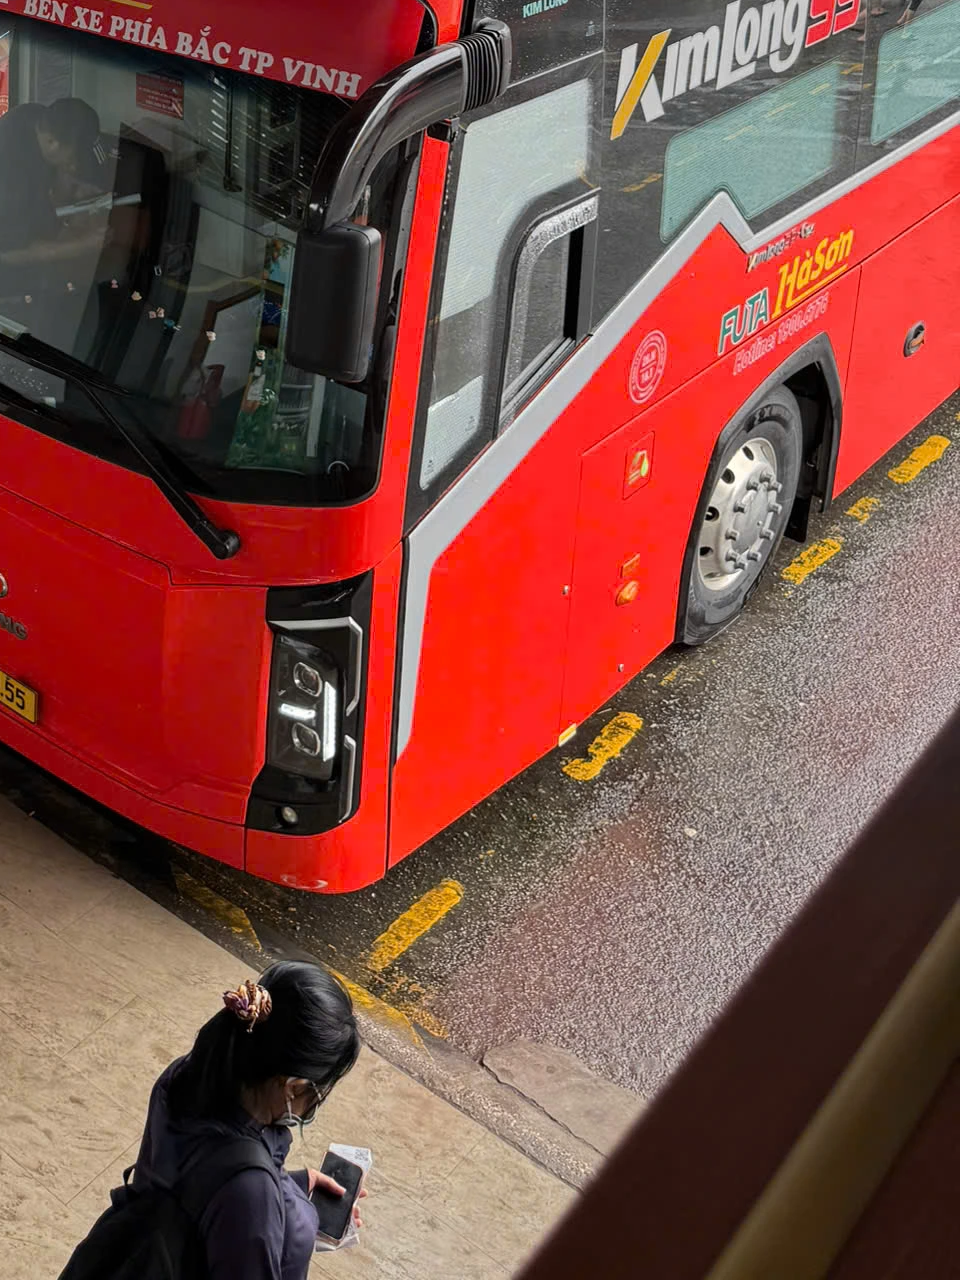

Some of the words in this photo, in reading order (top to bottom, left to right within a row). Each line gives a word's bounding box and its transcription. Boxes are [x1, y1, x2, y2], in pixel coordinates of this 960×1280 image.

[71, 5, 105, 31] XE
[108, 10, 170, 52] PHÍA
[175, 25, 232, 65] BẮC
[238, 46, 275, 76] TP
[281, 56, 363, 99] VINH
[522, 0, 544, 18] KIM
[718, 287, 769, 356] FUTA
[772, 229, 854, 319] HàSơn
